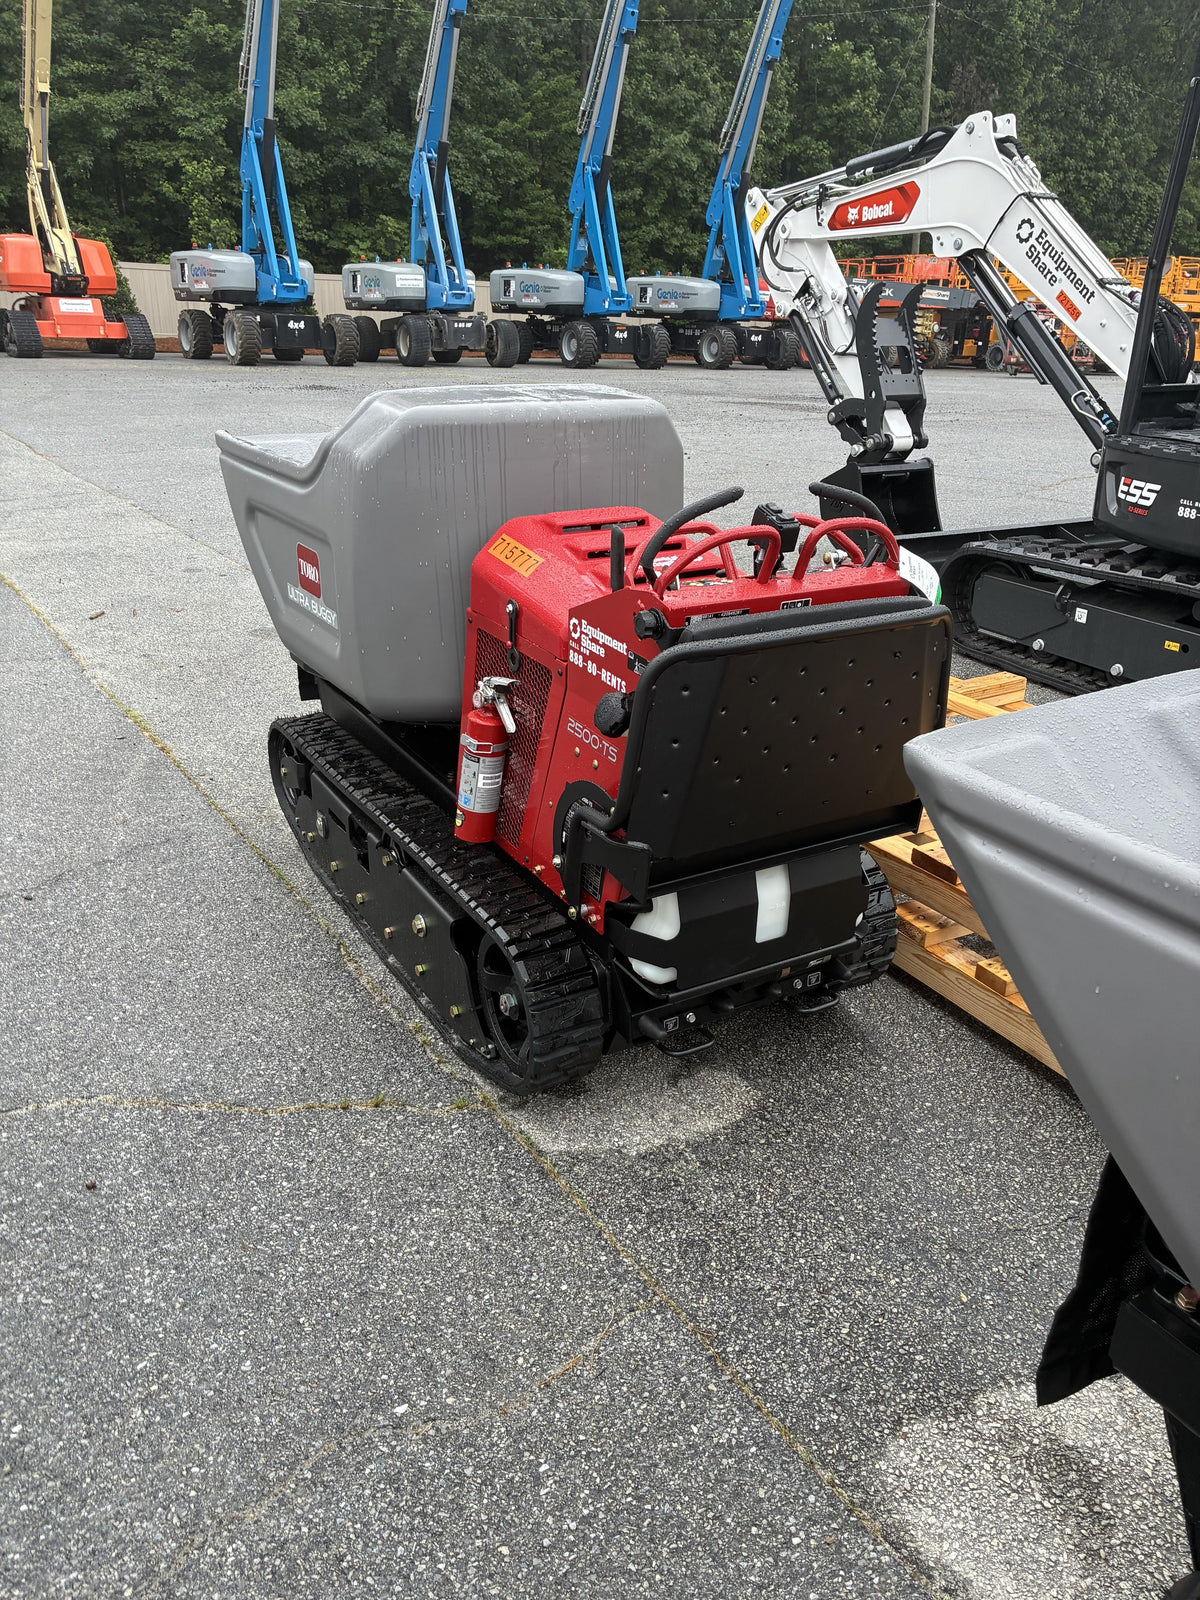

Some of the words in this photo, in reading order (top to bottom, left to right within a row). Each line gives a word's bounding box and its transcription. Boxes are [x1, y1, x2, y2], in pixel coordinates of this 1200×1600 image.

[862, 201, 894, 222] Bobcat
[190, 264, 206, 278] Genie
[1025, 244, 1058, 287] Share
[1035, 228, 1096, 304] Equipment
[363, 275, 381, 288] Genie
[520, 281, 540, 294] Genie
[656, 288, 678, 300] Genie
[1056, 290, 1081, 319] 721259
[288, 320, 305, 330] 4x4
[614, 331, 628, 340] 4x4
[751, 334, 762, 342] 4x4
[1118, 477, 1162, 507] ESS
[1180, 498, 1193, 506] CALL
[493, 537, 540, 572] 715777
[298, 558, 319, 583] TORO
[287, 583, 310, 611] ULTRA
[311, 599, 338, 626] BUGGY
[581, 619, 627, 655] Equipment
[581, 634, 605, 658] Share
[569, 649, 627, 694] 888-80-RENTS
